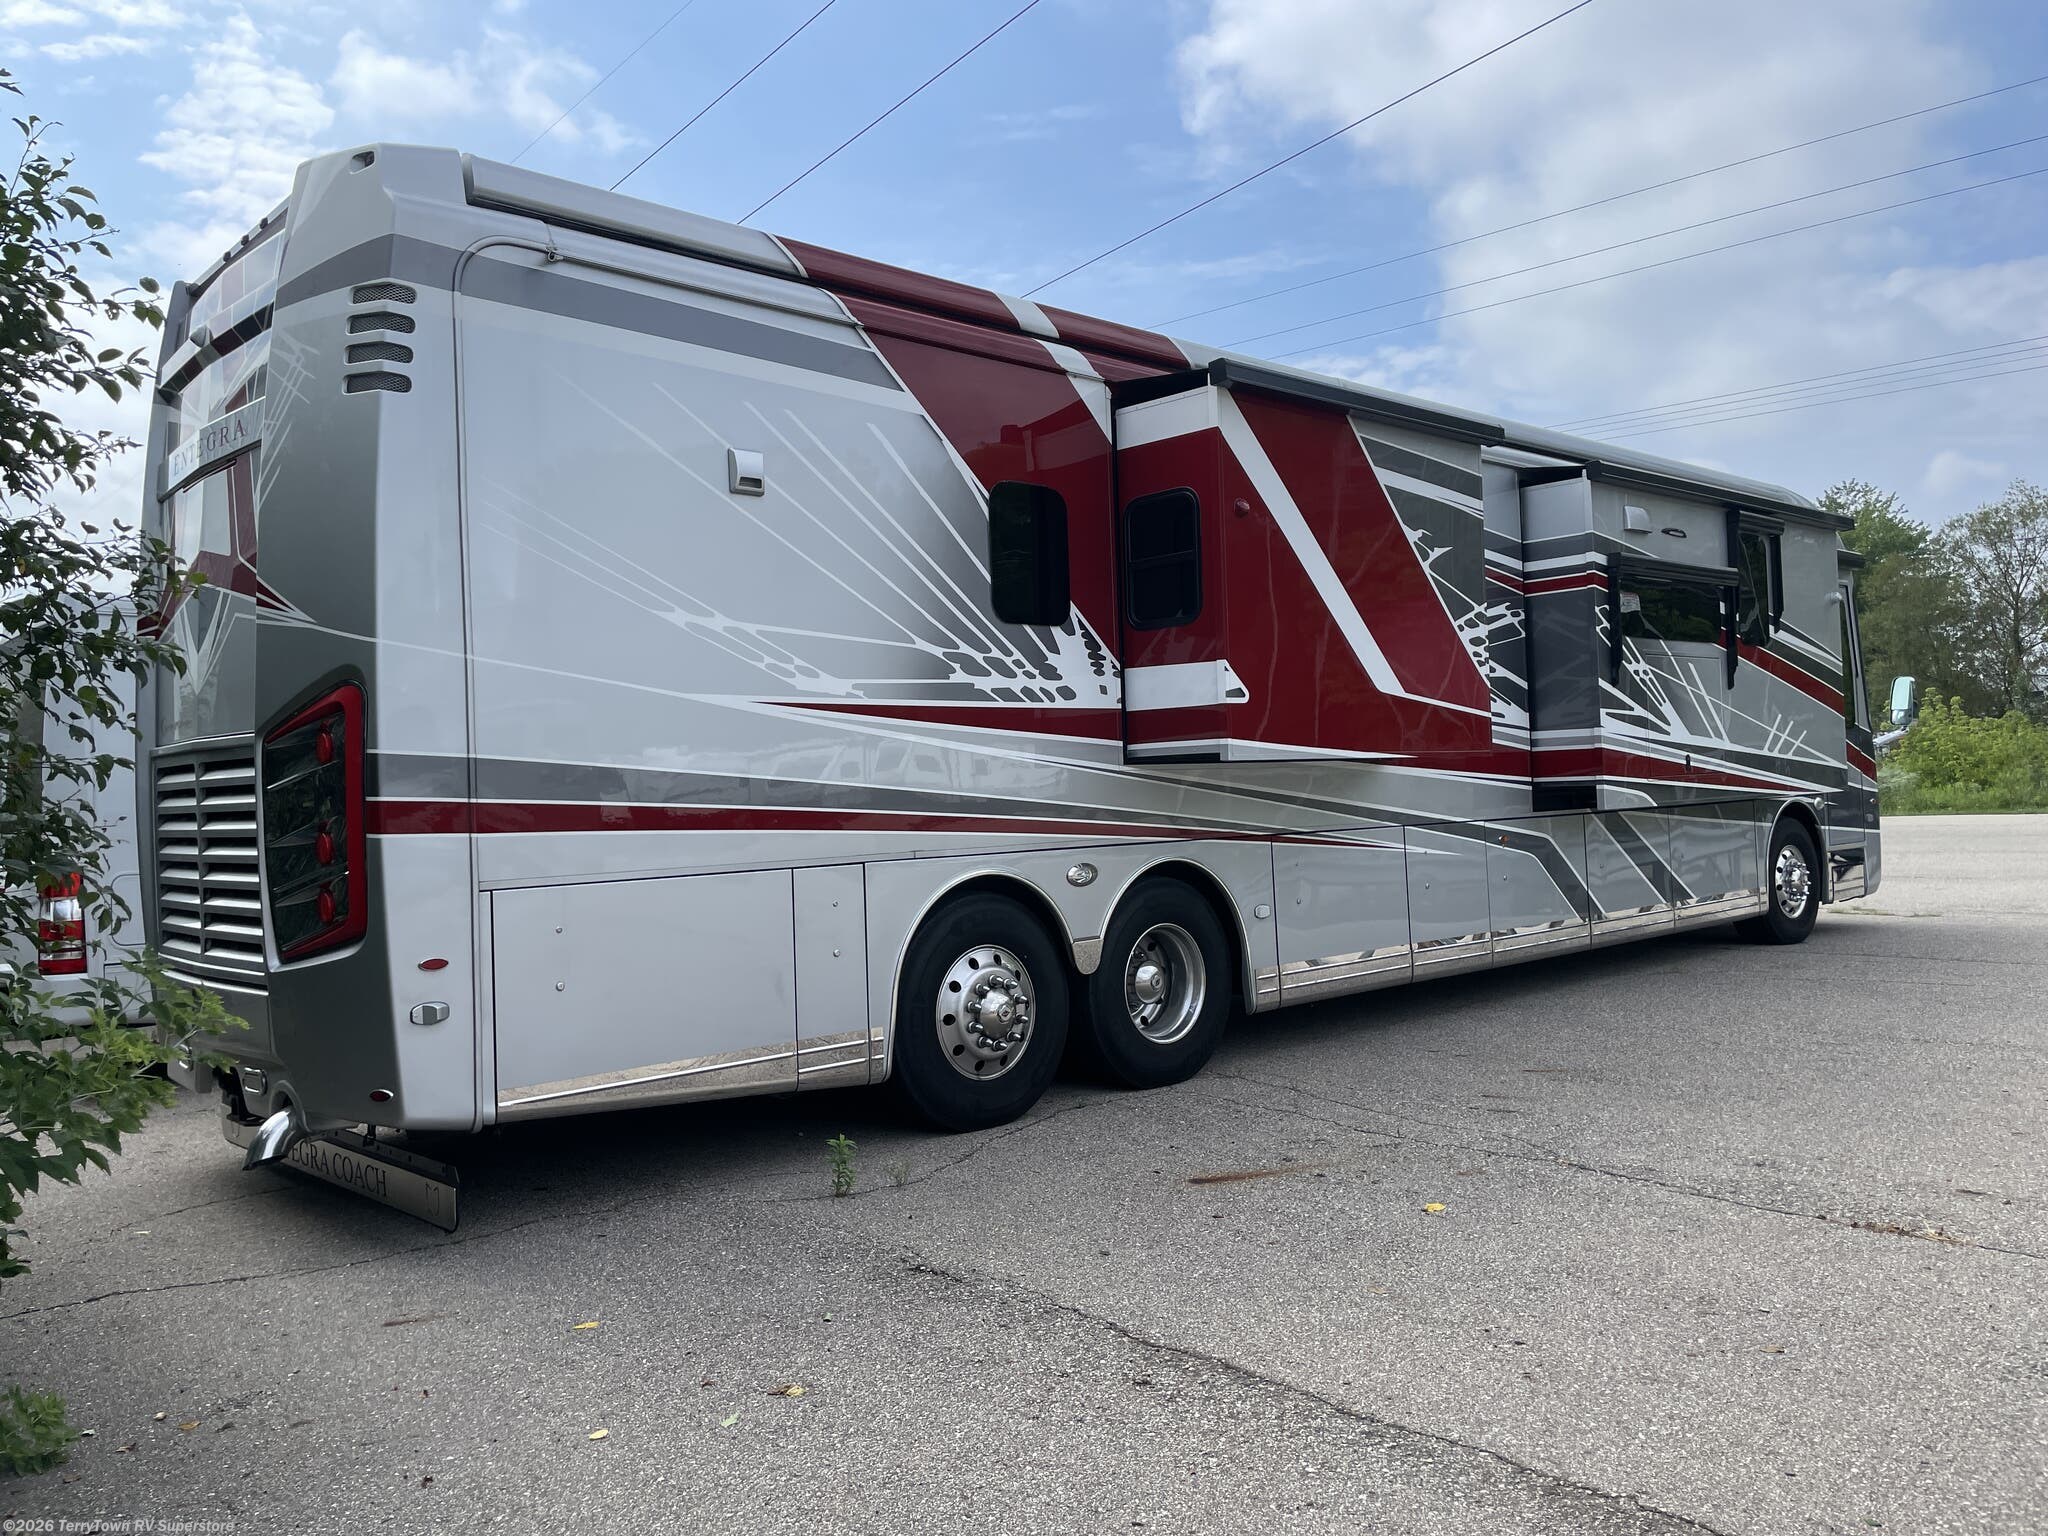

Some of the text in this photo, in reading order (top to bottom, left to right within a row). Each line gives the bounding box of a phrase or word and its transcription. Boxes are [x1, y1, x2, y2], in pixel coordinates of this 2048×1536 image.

[174, 419, 245, 476] ENTEGRA
[287, 1139, 387, 1197] EGRA COACH
